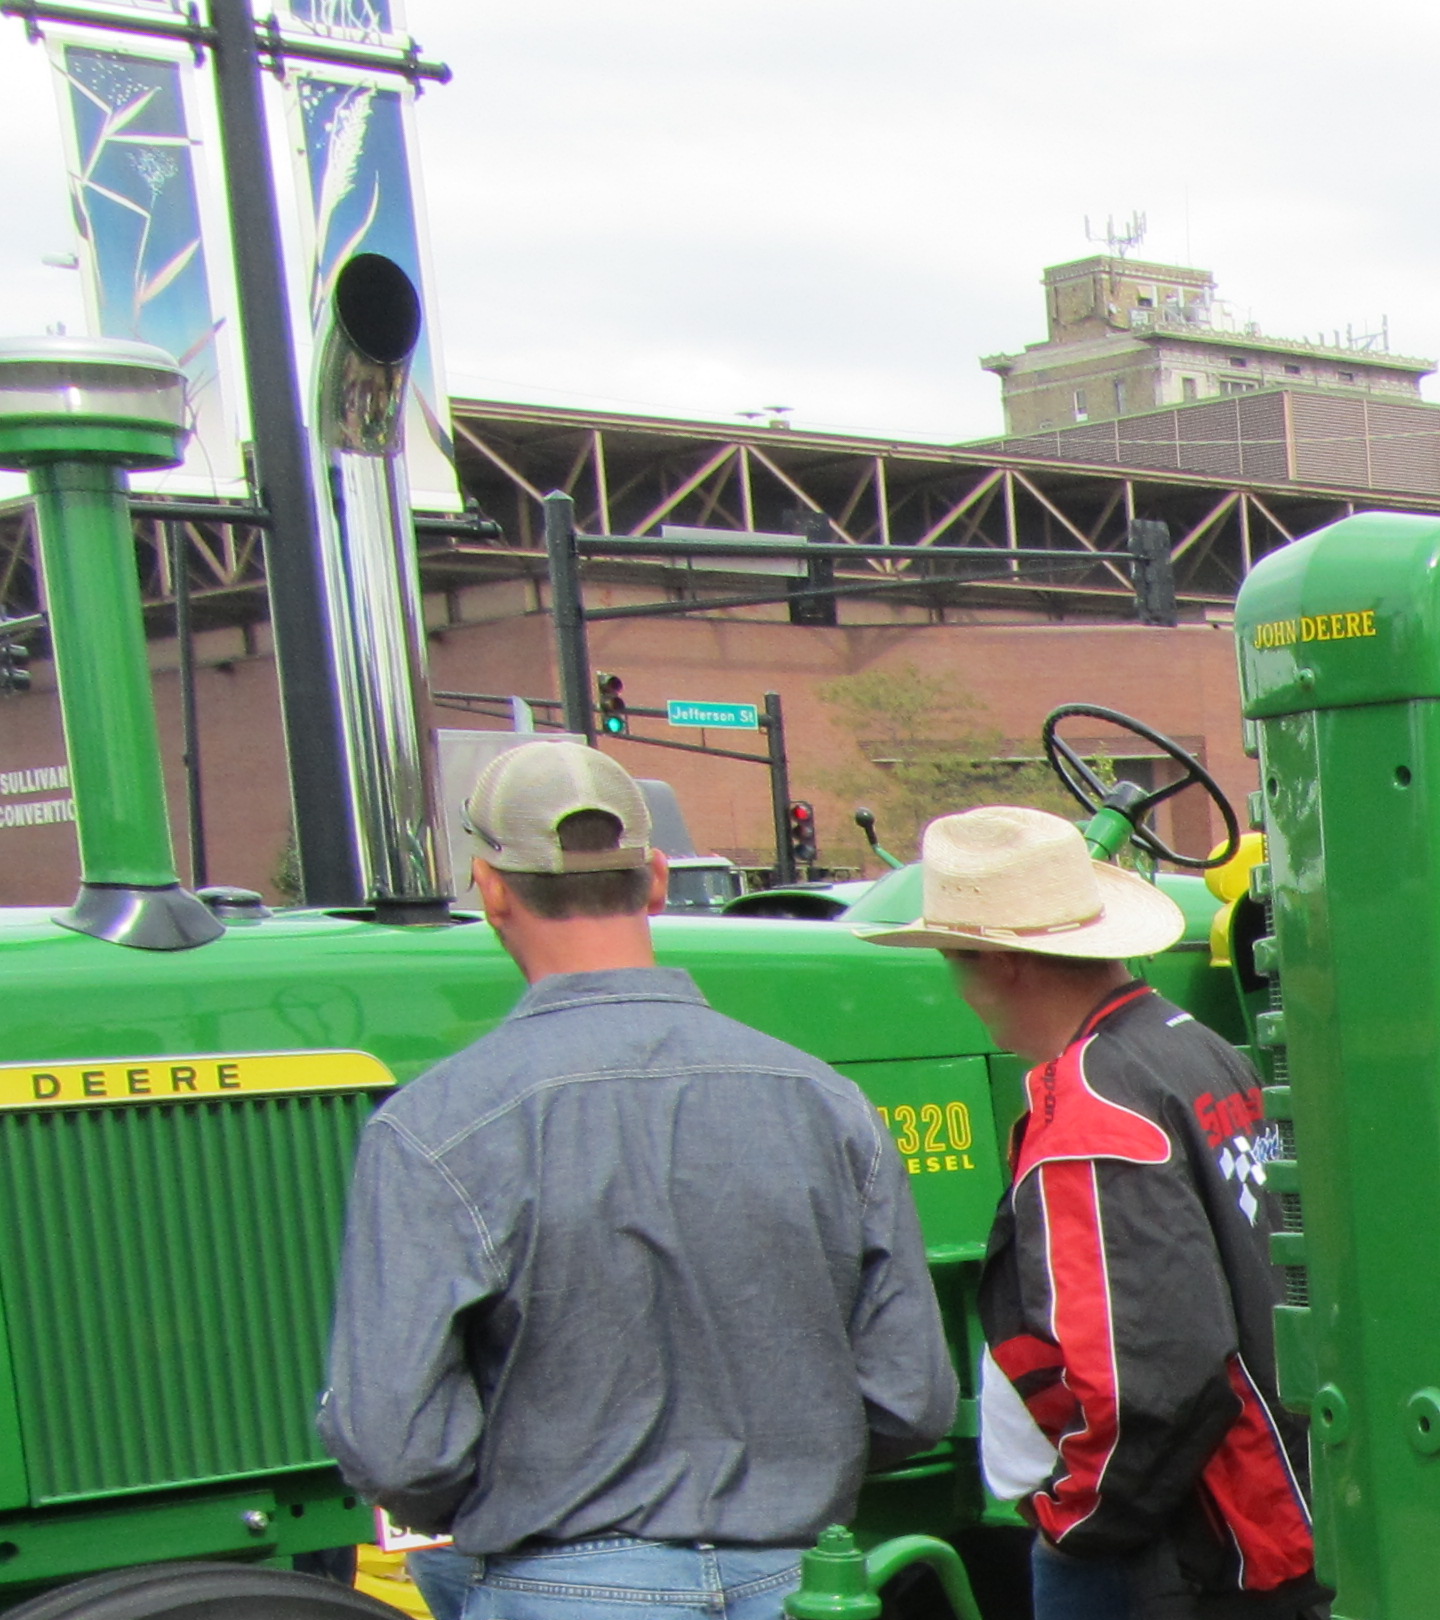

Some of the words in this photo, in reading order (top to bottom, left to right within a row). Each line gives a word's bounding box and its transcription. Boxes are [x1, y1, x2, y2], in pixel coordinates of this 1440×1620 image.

[1254, 620, 1297, 649] JOHN
[1301, 609, 1377, 642] DEERE
[672, 706, 735, 722] Jefferson
[740, 709, 755, 723] St
[0, 766, 69, 795] SULLIVAN
[32, 1063, 242, 1100] DEERE
